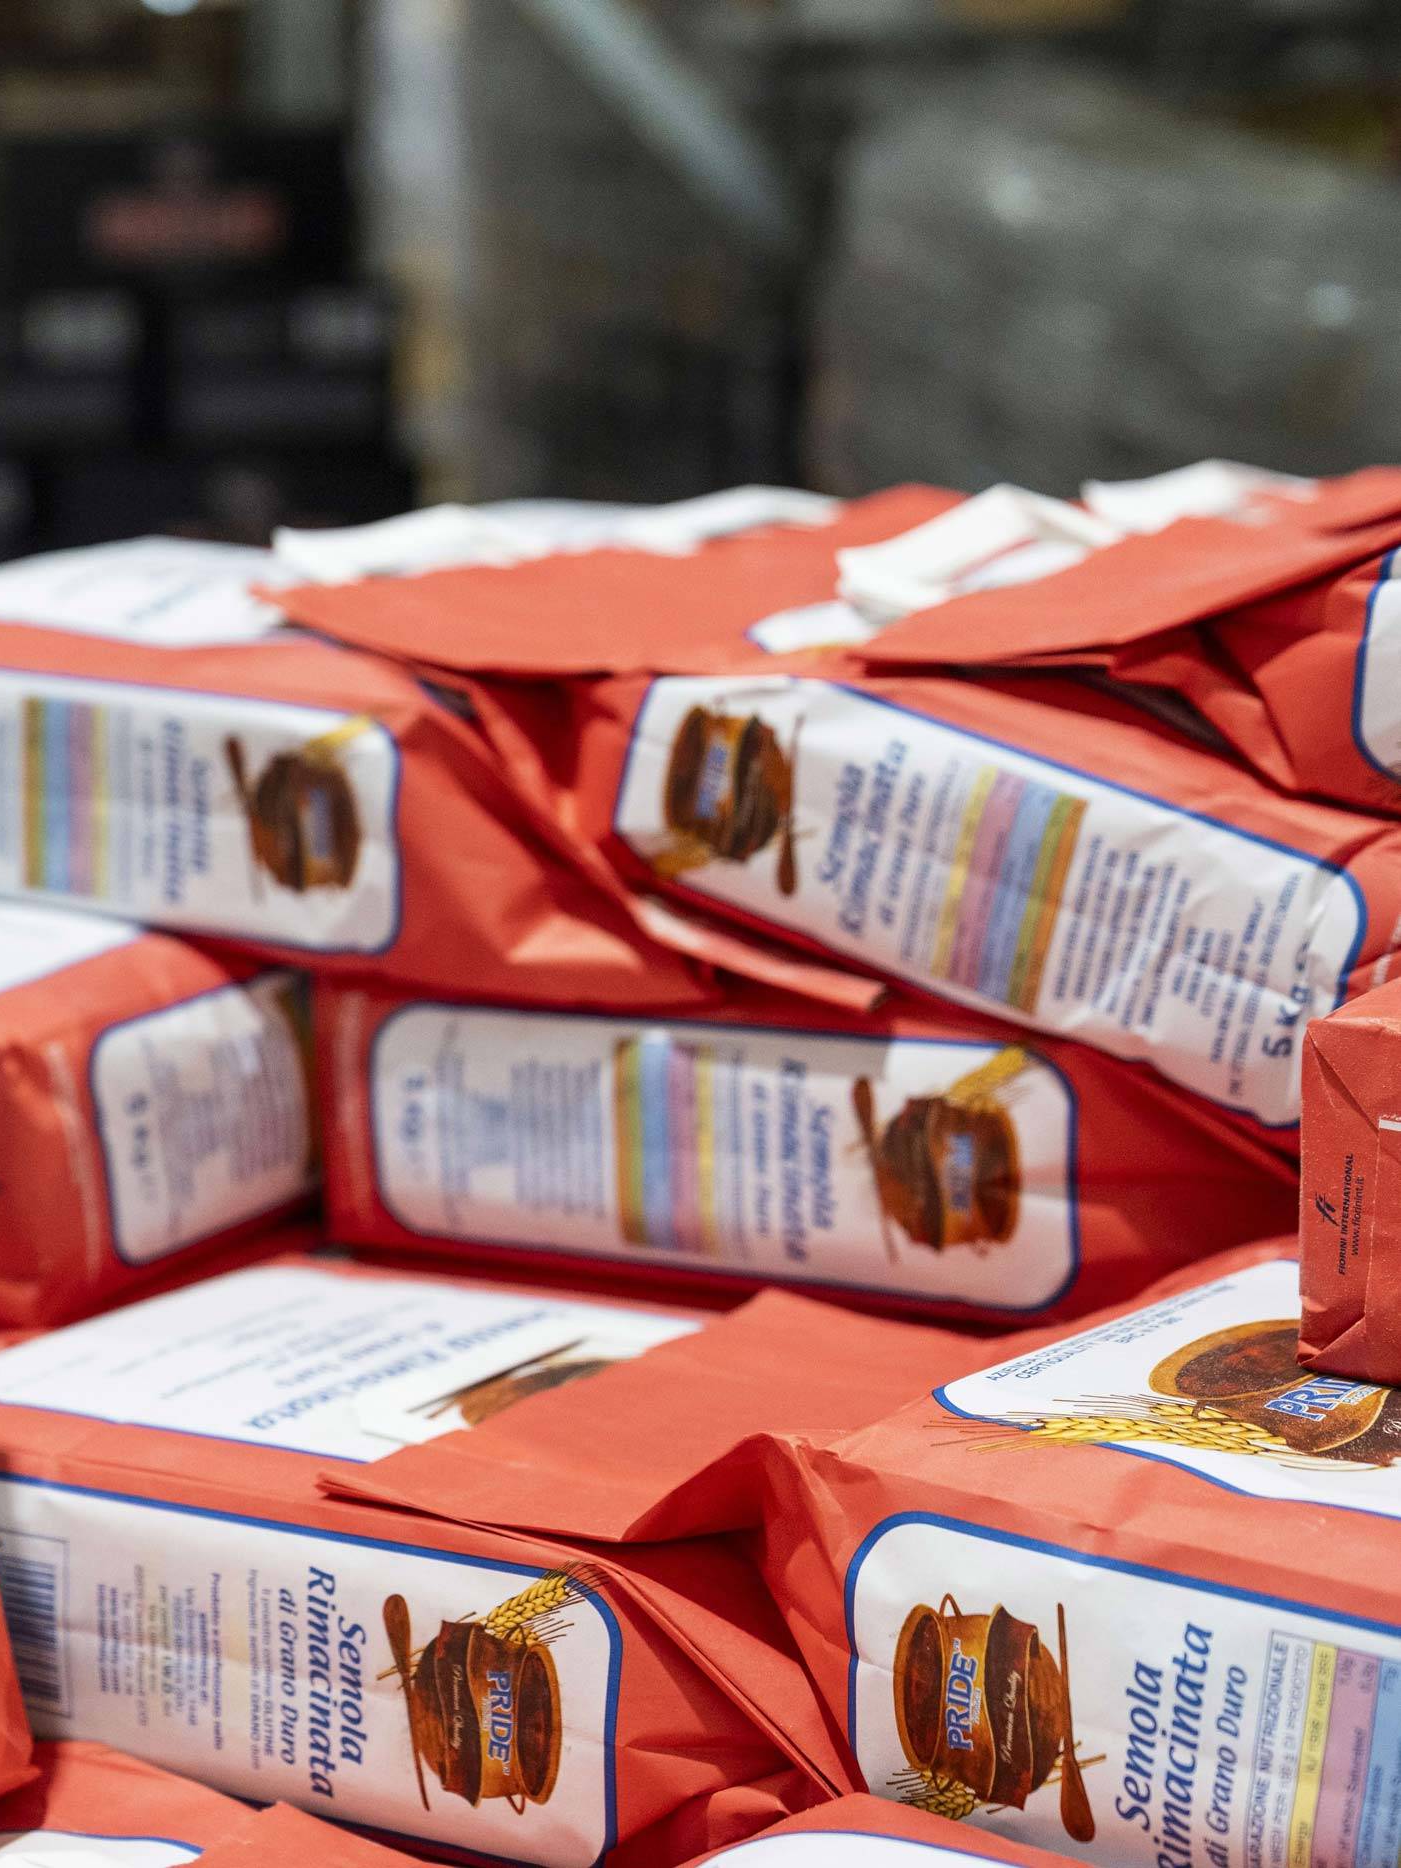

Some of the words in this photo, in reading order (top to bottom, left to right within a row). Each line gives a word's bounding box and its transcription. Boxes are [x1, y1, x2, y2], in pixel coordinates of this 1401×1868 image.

[1340, 1153, 1354, 1235] INTERNATIONAL
[1338, 1238, 1347, 1275] FIORINI
[985, 1357, 1038, 1382] AZIENDA
[279, 1587, 298, 1617] di
[280, 1620, 297, 1698] Grano
[307, 1566, 336, 1798] Rimacinata
[338, 1615, 367, 1766] Semola
[280, 1703, 298, 1766] Duro
[486, 1670, 513, 1762] PRIDE
[946, 1652, 978, 1752] PRIDE
[1216, 1664, 1248, 1739] Duro
[1115, 1660, 1163, 1832] Semola
[1154, 1621, 1213, 1868] Rimacinata
[1205, 1746, 1237, 1836] Grano
[1204, 1836, 1229, 1868] di
